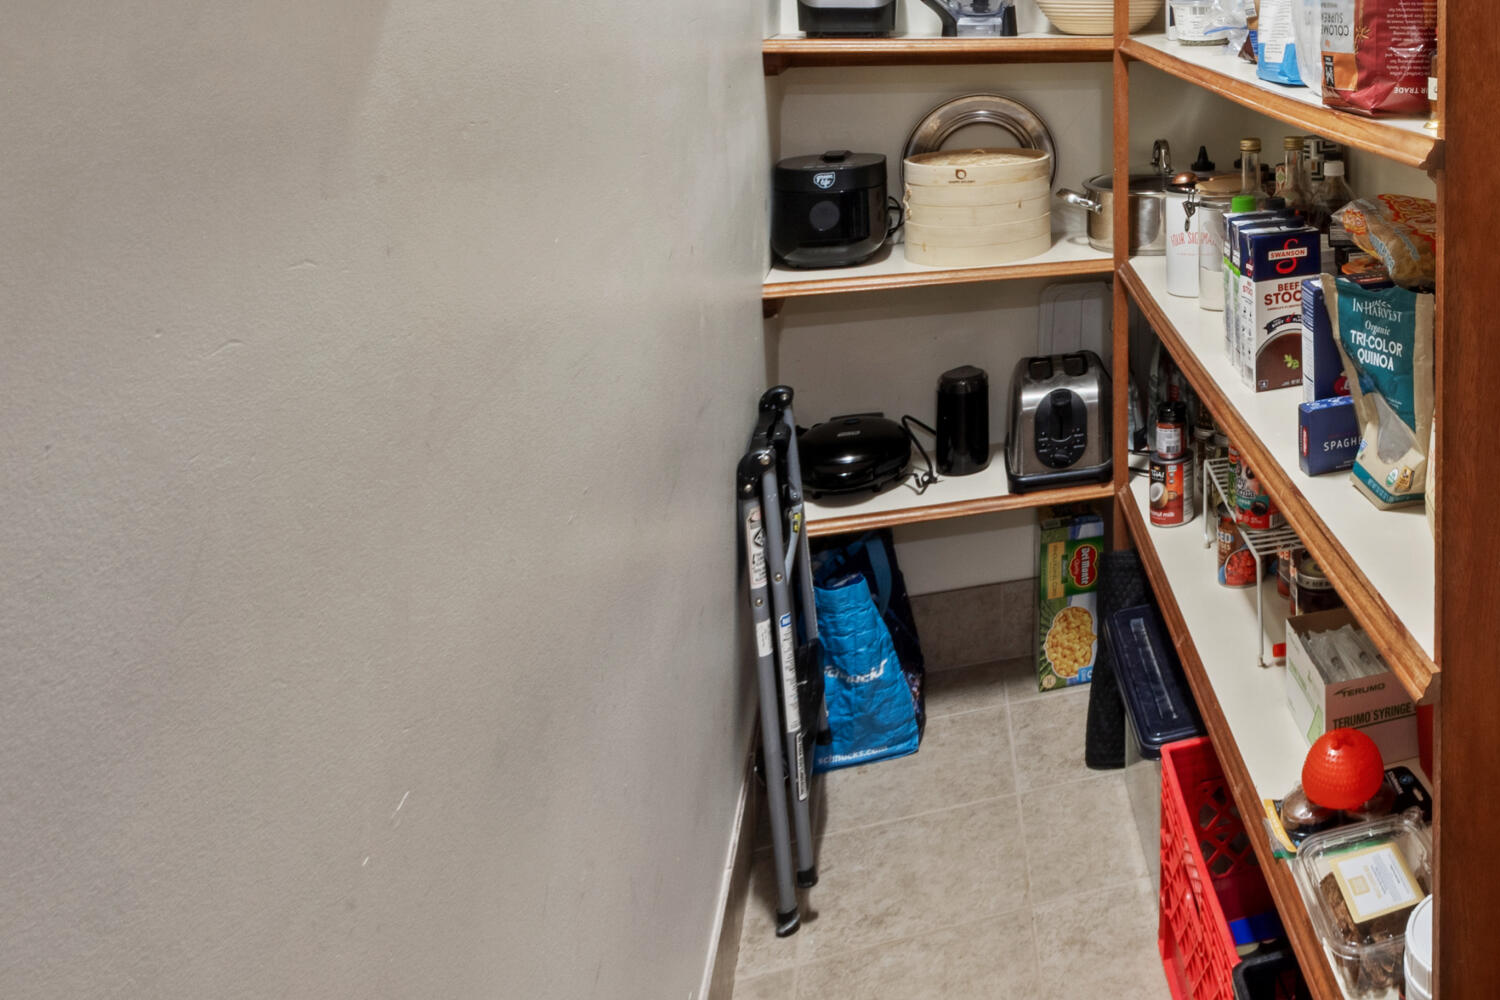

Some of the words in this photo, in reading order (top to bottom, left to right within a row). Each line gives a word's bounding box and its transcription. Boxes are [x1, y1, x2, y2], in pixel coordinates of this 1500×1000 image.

[1320, 25, 1349, 37] COLOM
[1393, 86, 1418, 94] TRADE
[1270, 249, 1305, 259] SWANSON
[1278, 281, 1300, 292] BEEF
[1264, 291, 1302, 306] STOC
[1365, 320, 1391, 336] Organic
[1350, 329, 1403, 357] TRI-COLOR
[1357, 348, 1395, 371] QUINOA
[1323, 435, 1363, 452] SPAGHE
[1081, 561, 1090, 585] Monte
[1335, 683, 1386, 697] TERUMO
[1333, 711, 1370, 730] TERUMO
[1374, 703, 1412, 721] SYRINGE
